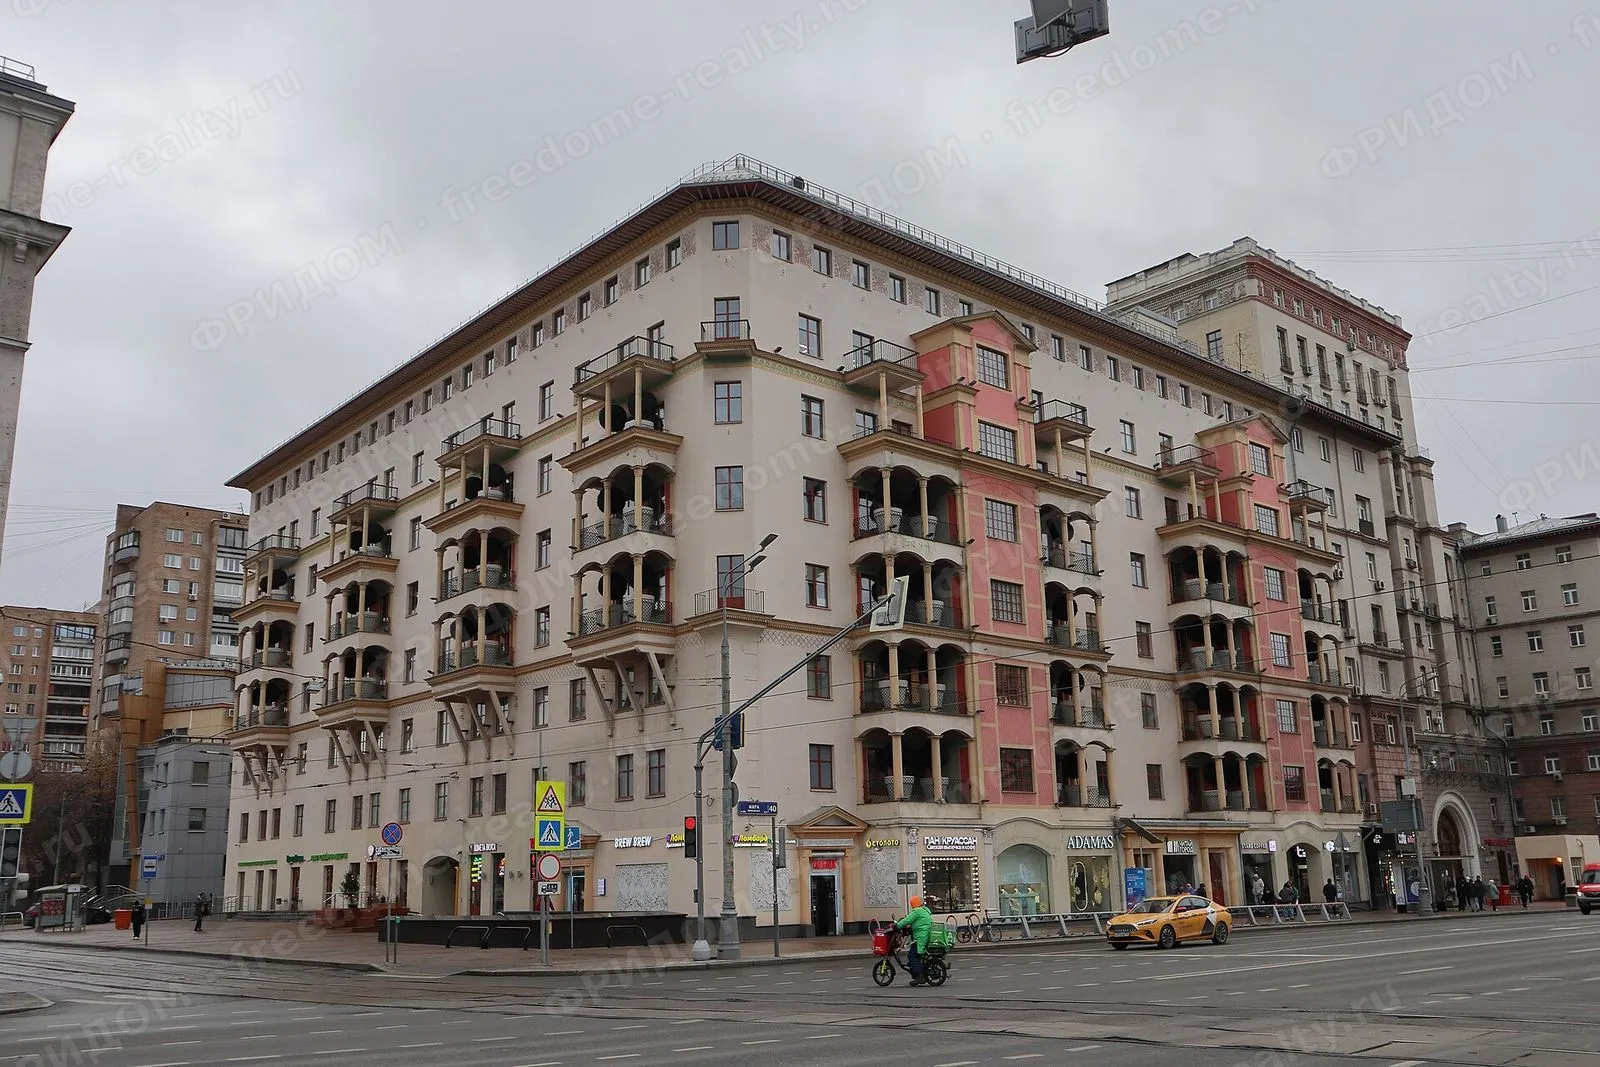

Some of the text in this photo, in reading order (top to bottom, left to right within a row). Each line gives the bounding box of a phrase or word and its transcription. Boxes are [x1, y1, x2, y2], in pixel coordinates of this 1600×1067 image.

[768, 805, 777, 813] 40
[614, 837, 633, 849] BREW
[633, 835, 652, 848] BREW
[739, 834, 769, 843] Ломбард
[924, 836, 978, 846] ПАН КРУАССАН
[1067, 835, 1114, 849] ADAMAS
